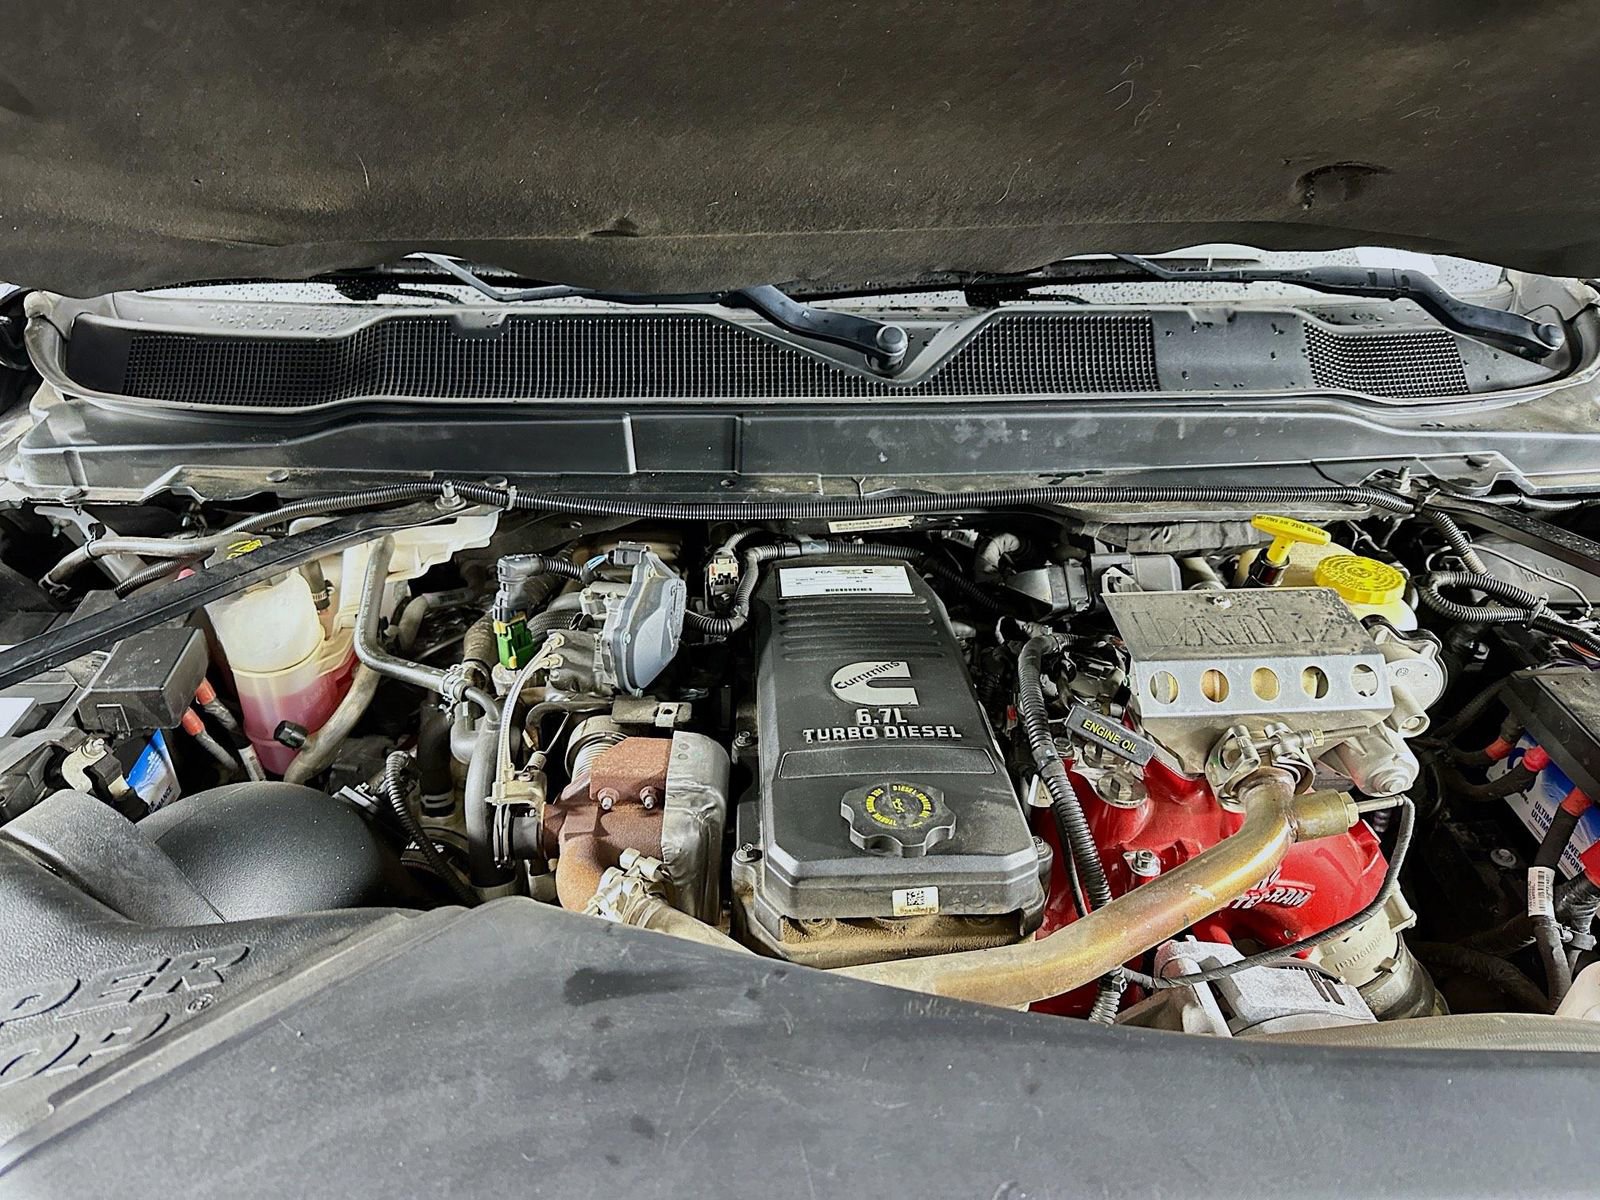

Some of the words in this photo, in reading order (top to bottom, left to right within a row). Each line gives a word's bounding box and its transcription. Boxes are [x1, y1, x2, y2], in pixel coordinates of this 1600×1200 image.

[834, 661, 900, 690] Cummins
[855, 708, 908, 726] 6.7L
[802, 726, 878, 744] TURBO
[883, 725, 963, 740] DIESEL
[1083, 719, 1120, 745] ENGINE
[1121, 739, 1138, 754] OIL
